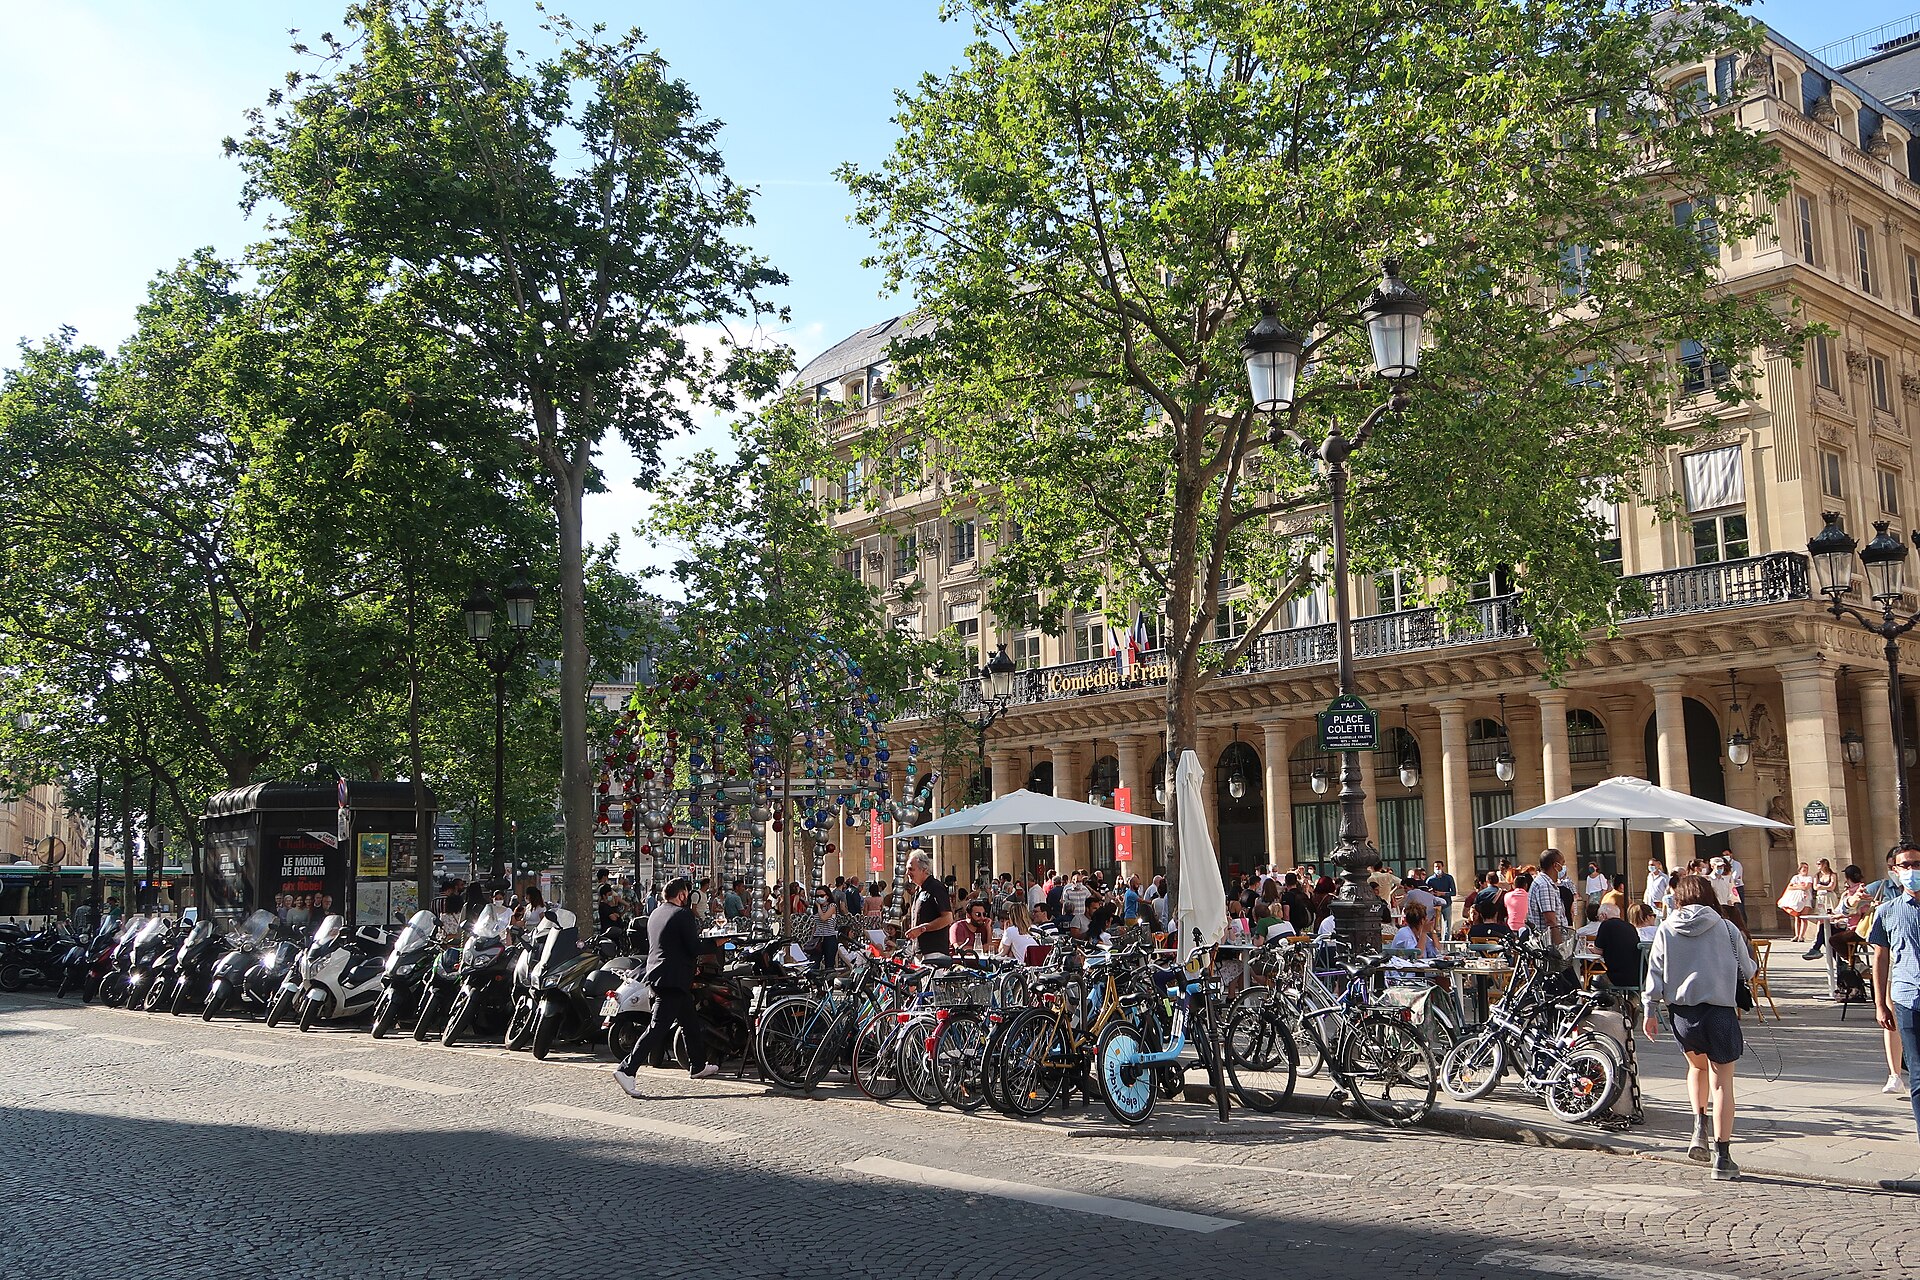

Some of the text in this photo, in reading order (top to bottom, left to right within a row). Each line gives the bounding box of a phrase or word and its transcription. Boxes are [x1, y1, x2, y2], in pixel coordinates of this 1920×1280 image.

[1334, 715, 1364, 724] PLACE
[1328, 724, 1370, 733] COLETTE
[284, 857, 324, 866] LE MONDE
[281, 867, 326, 876] DE DEMAIN
